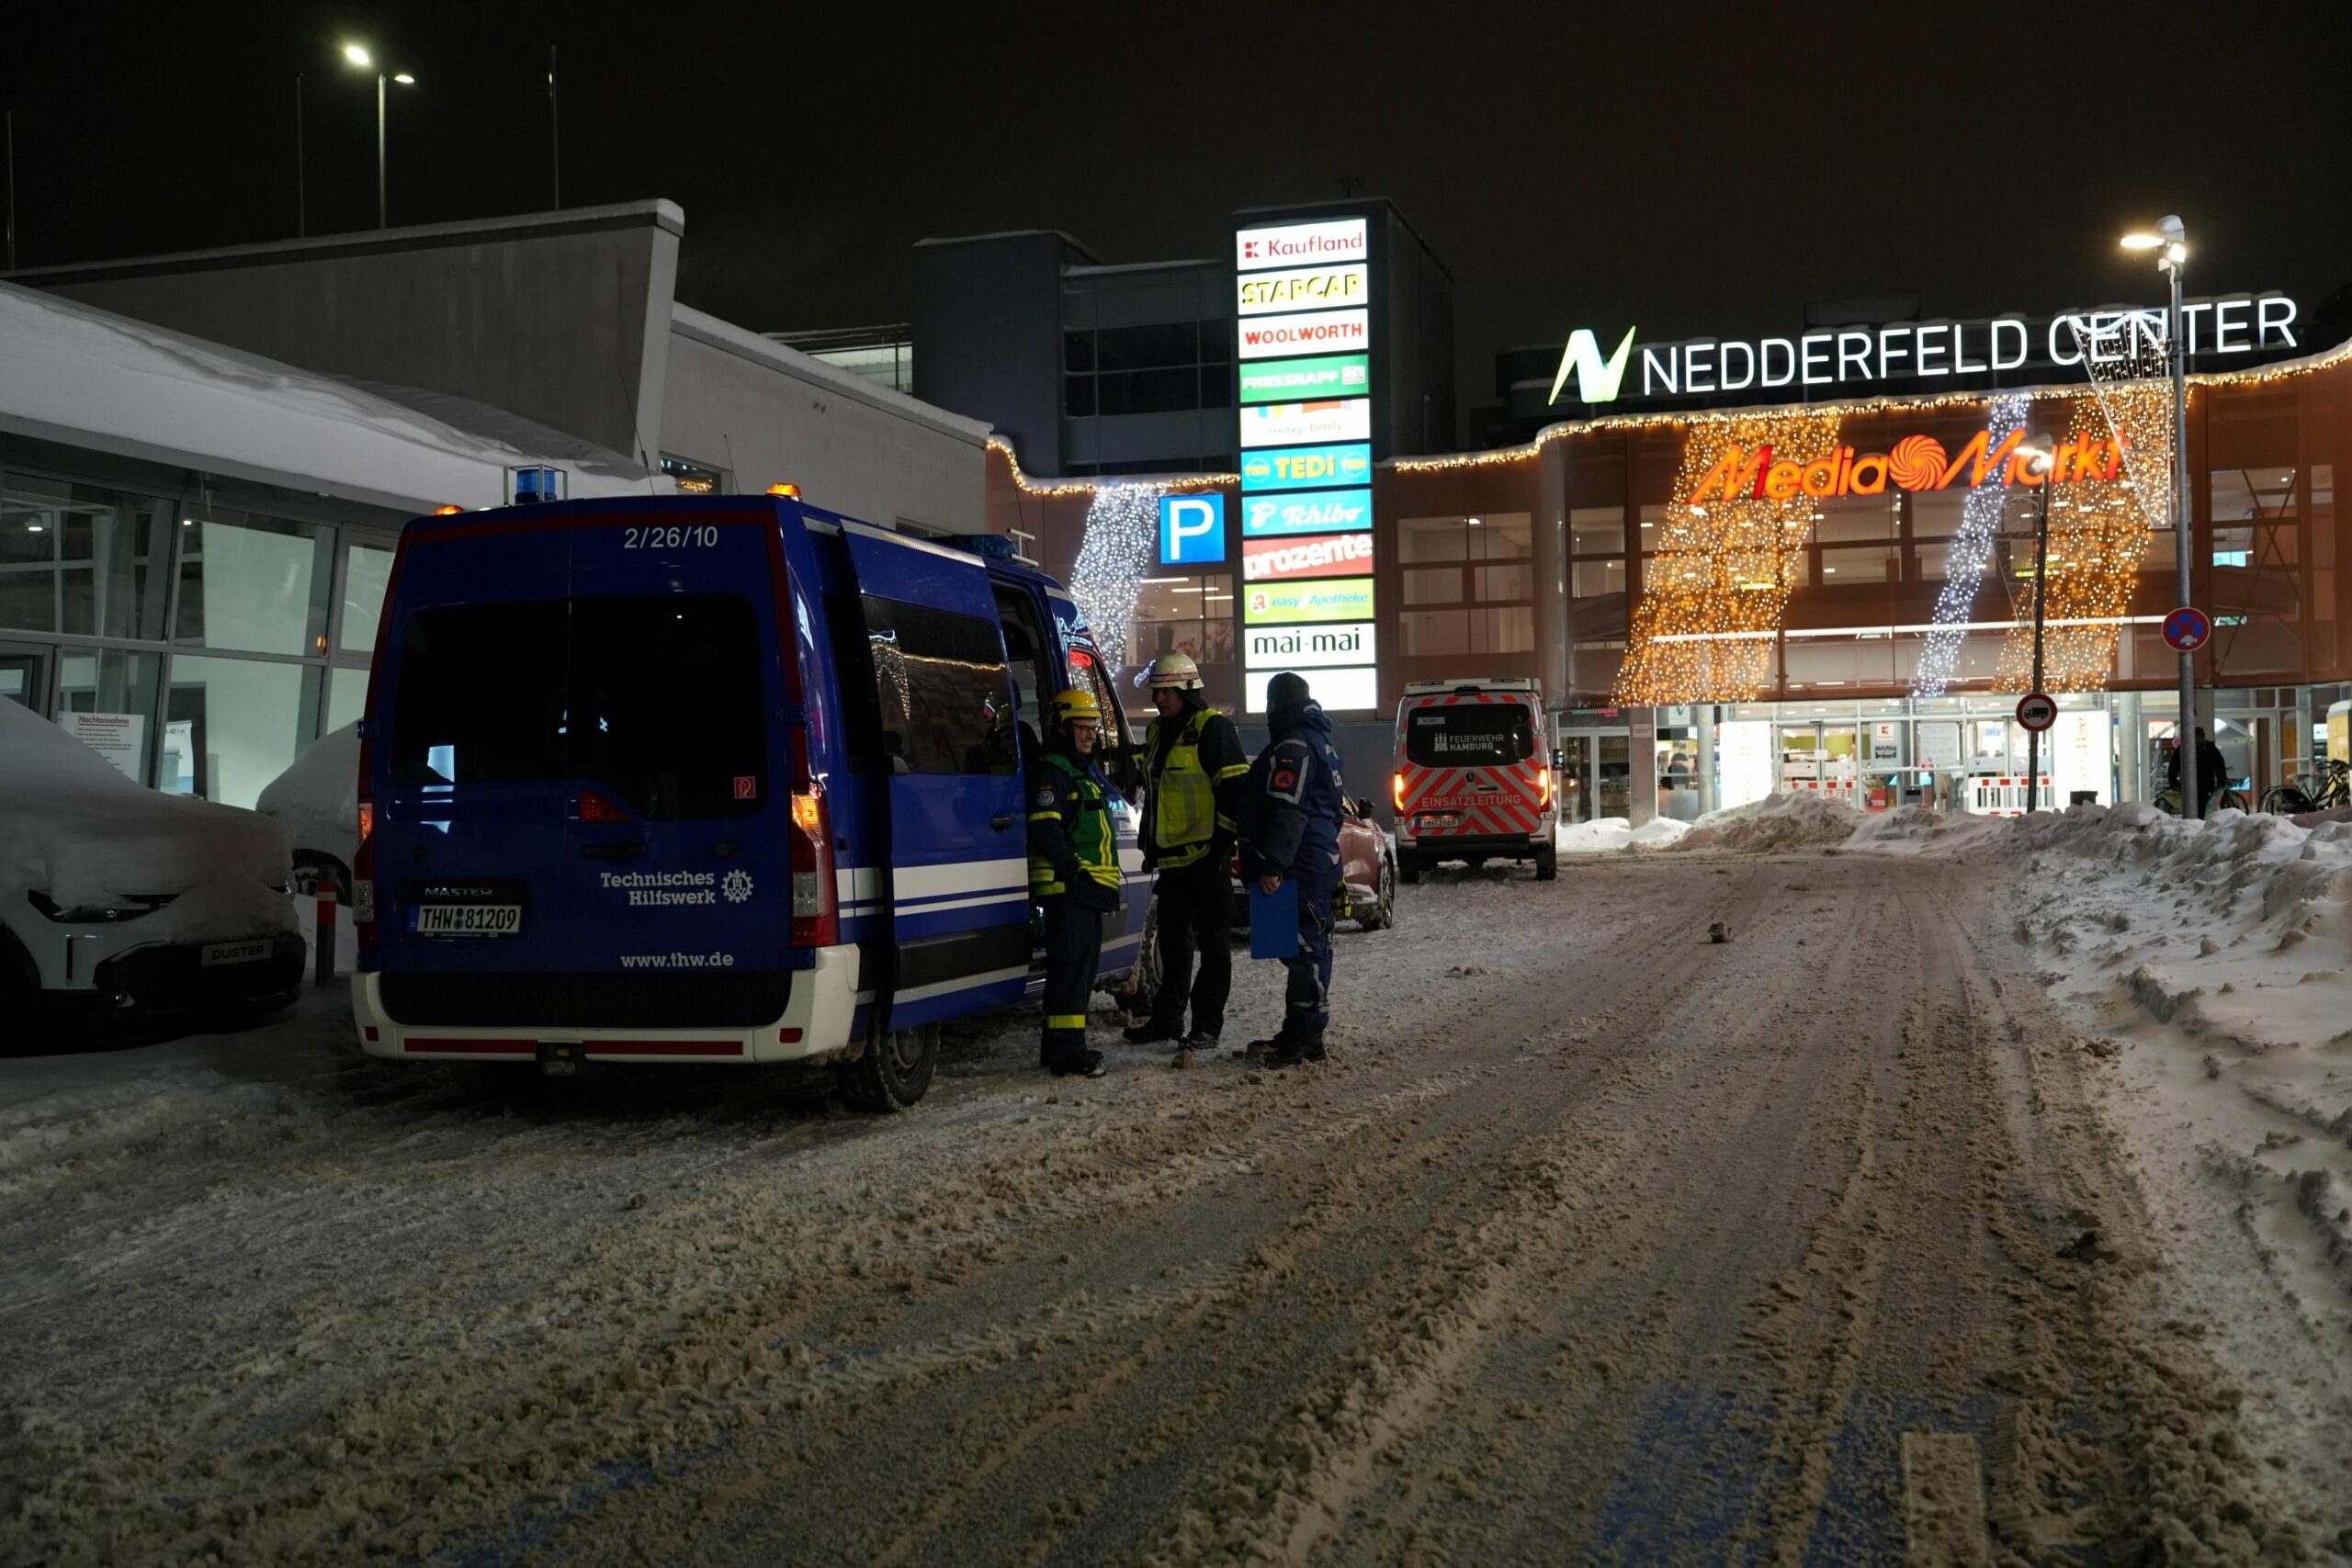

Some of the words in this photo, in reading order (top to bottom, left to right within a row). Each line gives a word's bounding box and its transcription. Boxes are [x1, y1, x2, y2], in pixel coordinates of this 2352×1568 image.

[1268, 231, 1363, 257] Kaufland
[1242, 274, 1360, 304] STARCAR
[1245, 322, 1363, 345] WOOLWORTH
[1642, 318, 2030, 397] NEDDERFELD
[2048, 297, 2298, 367] CENTER
[1274, 455, 1336, 479] TEDi
[1688, 444, 1889, 505] Media
[1932, 427, 2132, 491] Markt
[1281, 502, 1365, 527] Tchibo
[624, 525, 718, 550] 2/26/10
[1170, 499, 1215, 560] P
[1243, 534, 1373, 580] prozente
[1308, 592, 1368, 606] Apotheke
[1254, 626, 1360, 655] mai-mai
[78, 715, 130, 726] Nachtannahme
[1449, 734, 1504, 743] FEUERWEHR
[1449, 743, 1494, 752] HAMBURG
[1421, 794, 1521, 808] EINSATZLEITUNG
[1437, 818, 1456, 827] 2969
[601, 870, 715, 888] Technisches
[424, 886, 493, 897] MASTER
[628, 889, 716, 907] Hilfswerk
[423, 908, 453, 930] THW
[465, 908, 516, 930] 81209
[210, 944, 266, 961] DUSTER
[620, 952, 734, 969] www.thw.de
